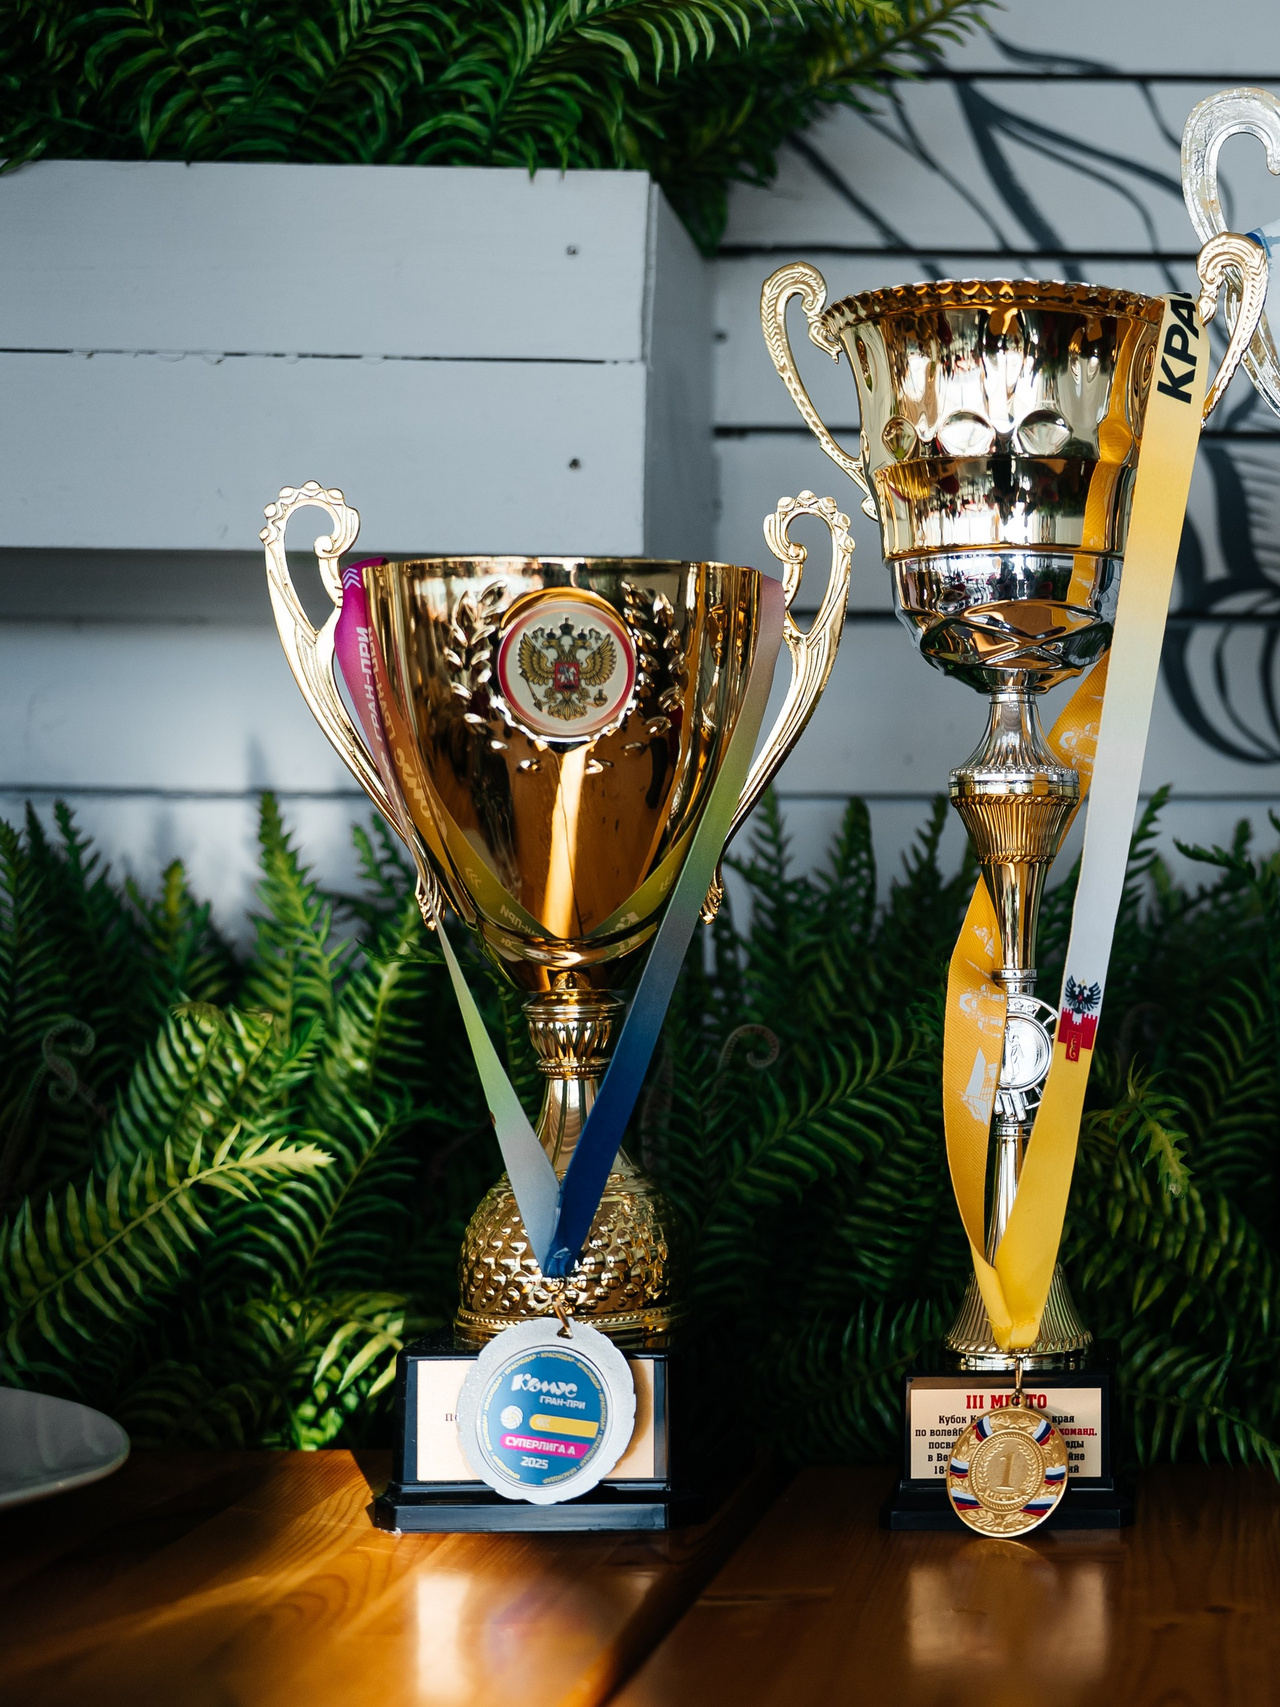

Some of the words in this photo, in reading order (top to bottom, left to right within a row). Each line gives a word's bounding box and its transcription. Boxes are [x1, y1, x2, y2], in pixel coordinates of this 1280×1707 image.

[356, 627, 383, 741] ГРАН-ПРИ
[539, 1395, 586, 1410] ГРАН-ПРИ
[938, 1414, 967, 1426] Кубок
[1051, 1415, 1075, 1425] края
[915, 1429, 927, 1437] по
[505, 1436, 566, 1454] СУПЕРЛИГА
[567, 1445, 576, 1455] А
[520, 1456, 549, 1470] 2025
[927, 1453, 934, 1461] в
